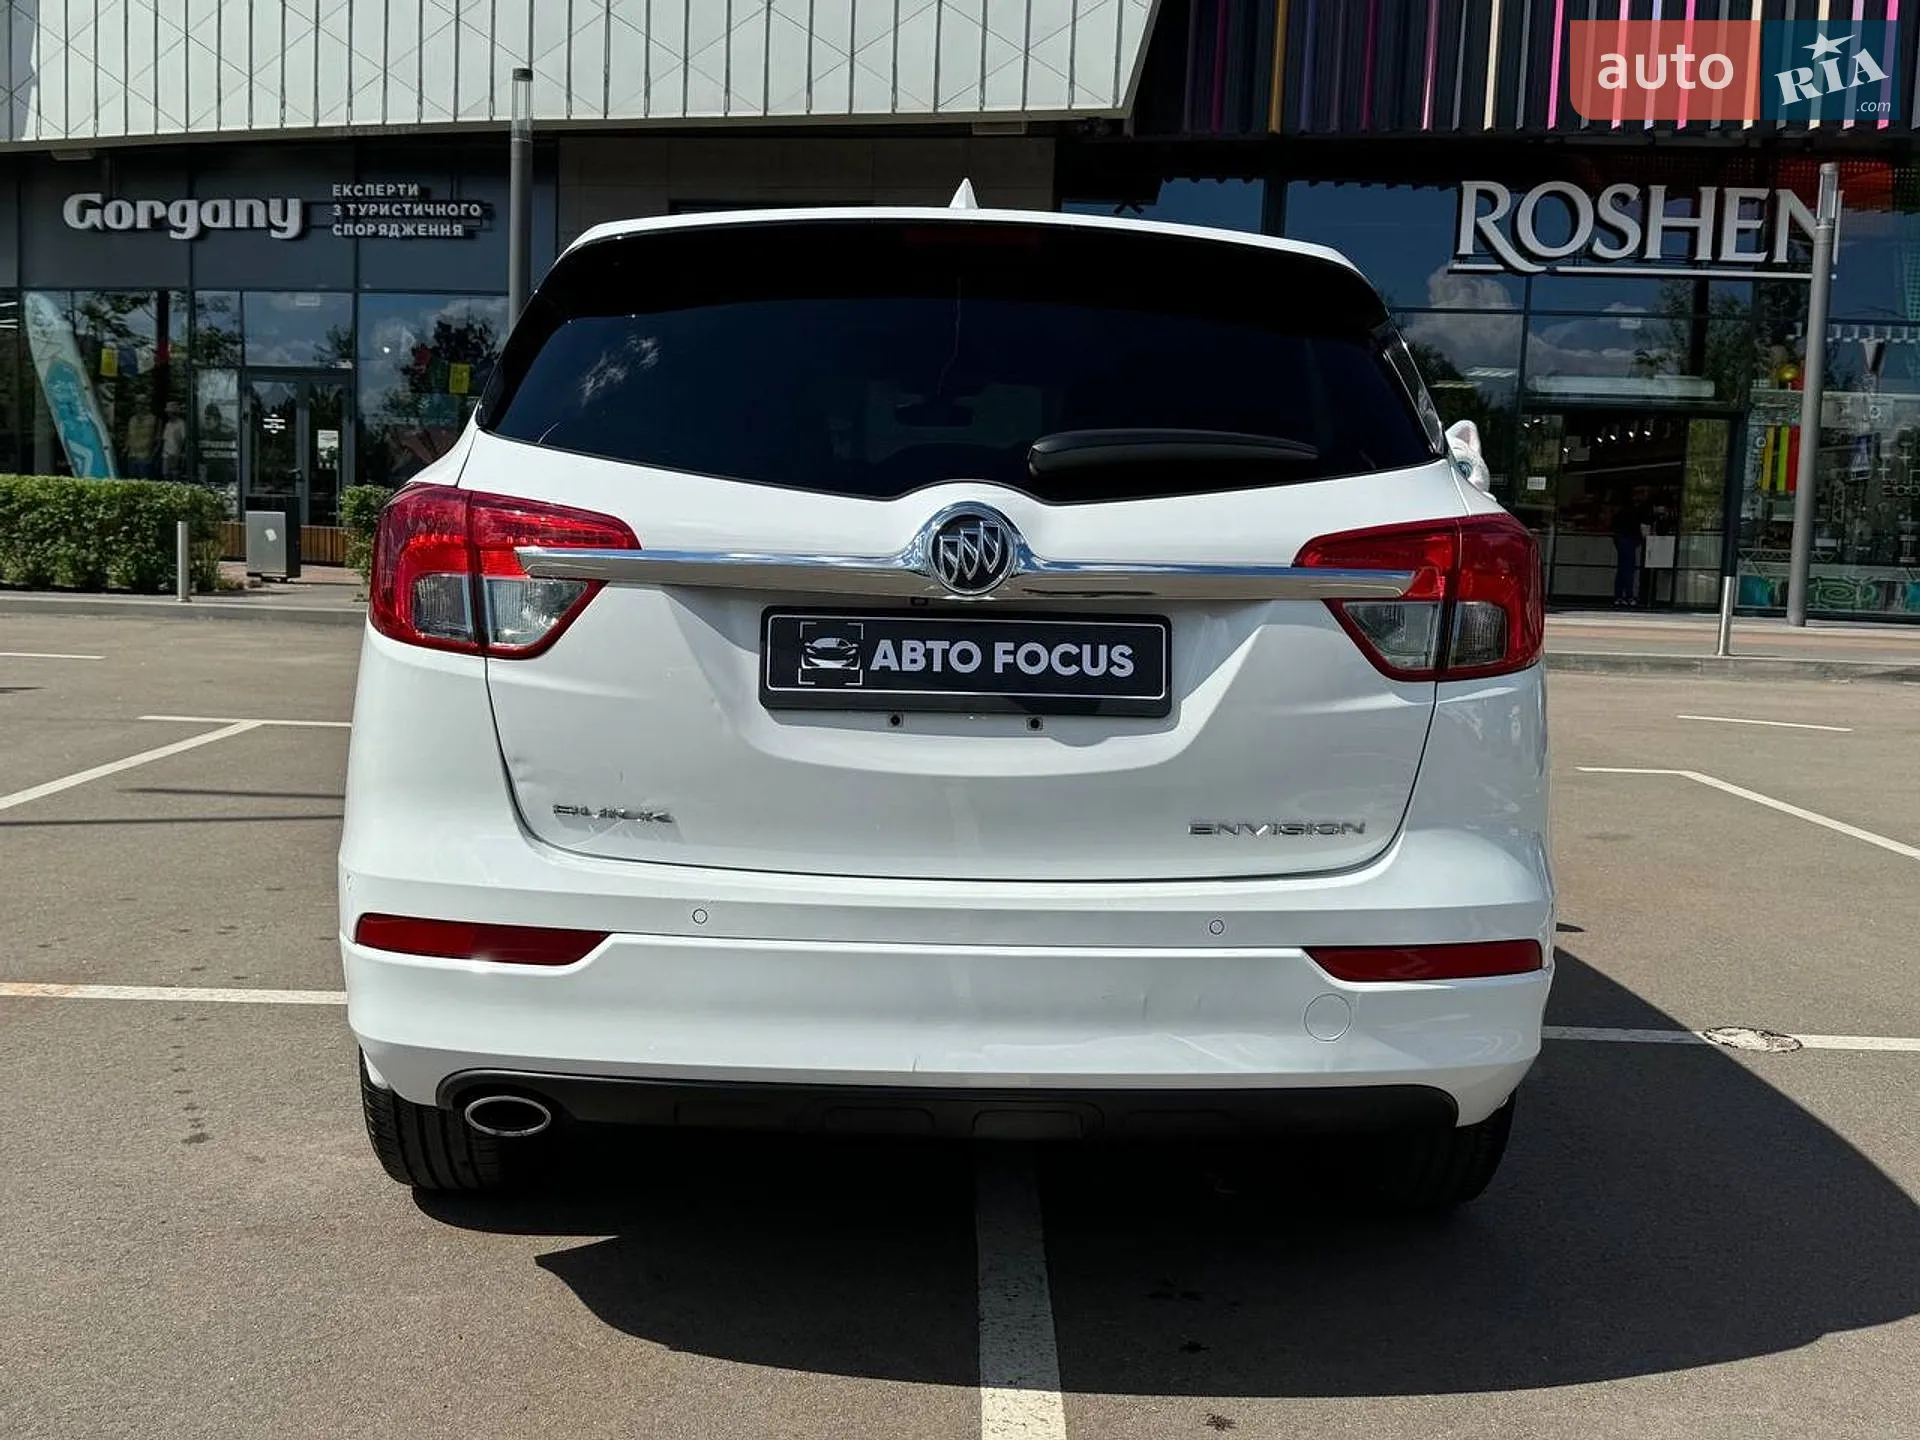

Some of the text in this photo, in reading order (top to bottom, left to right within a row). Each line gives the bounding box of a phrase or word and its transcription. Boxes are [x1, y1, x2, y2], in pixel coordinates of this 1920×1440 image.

[332, 184, 419, 197] ЕКСПЕРТИ
[62, 193, 302, 239] Gorgany
[347, 204, 483, 216] ТУРИСТИЧНОГО
[332, 224, 465, 238] СПОРЯДЖЕННЯ
[1456, 180, 1844, 273] ROSHEN
[994, 643, 1135, 678] FOCUS
[1188, 822, 1366, 837] ENVISION
